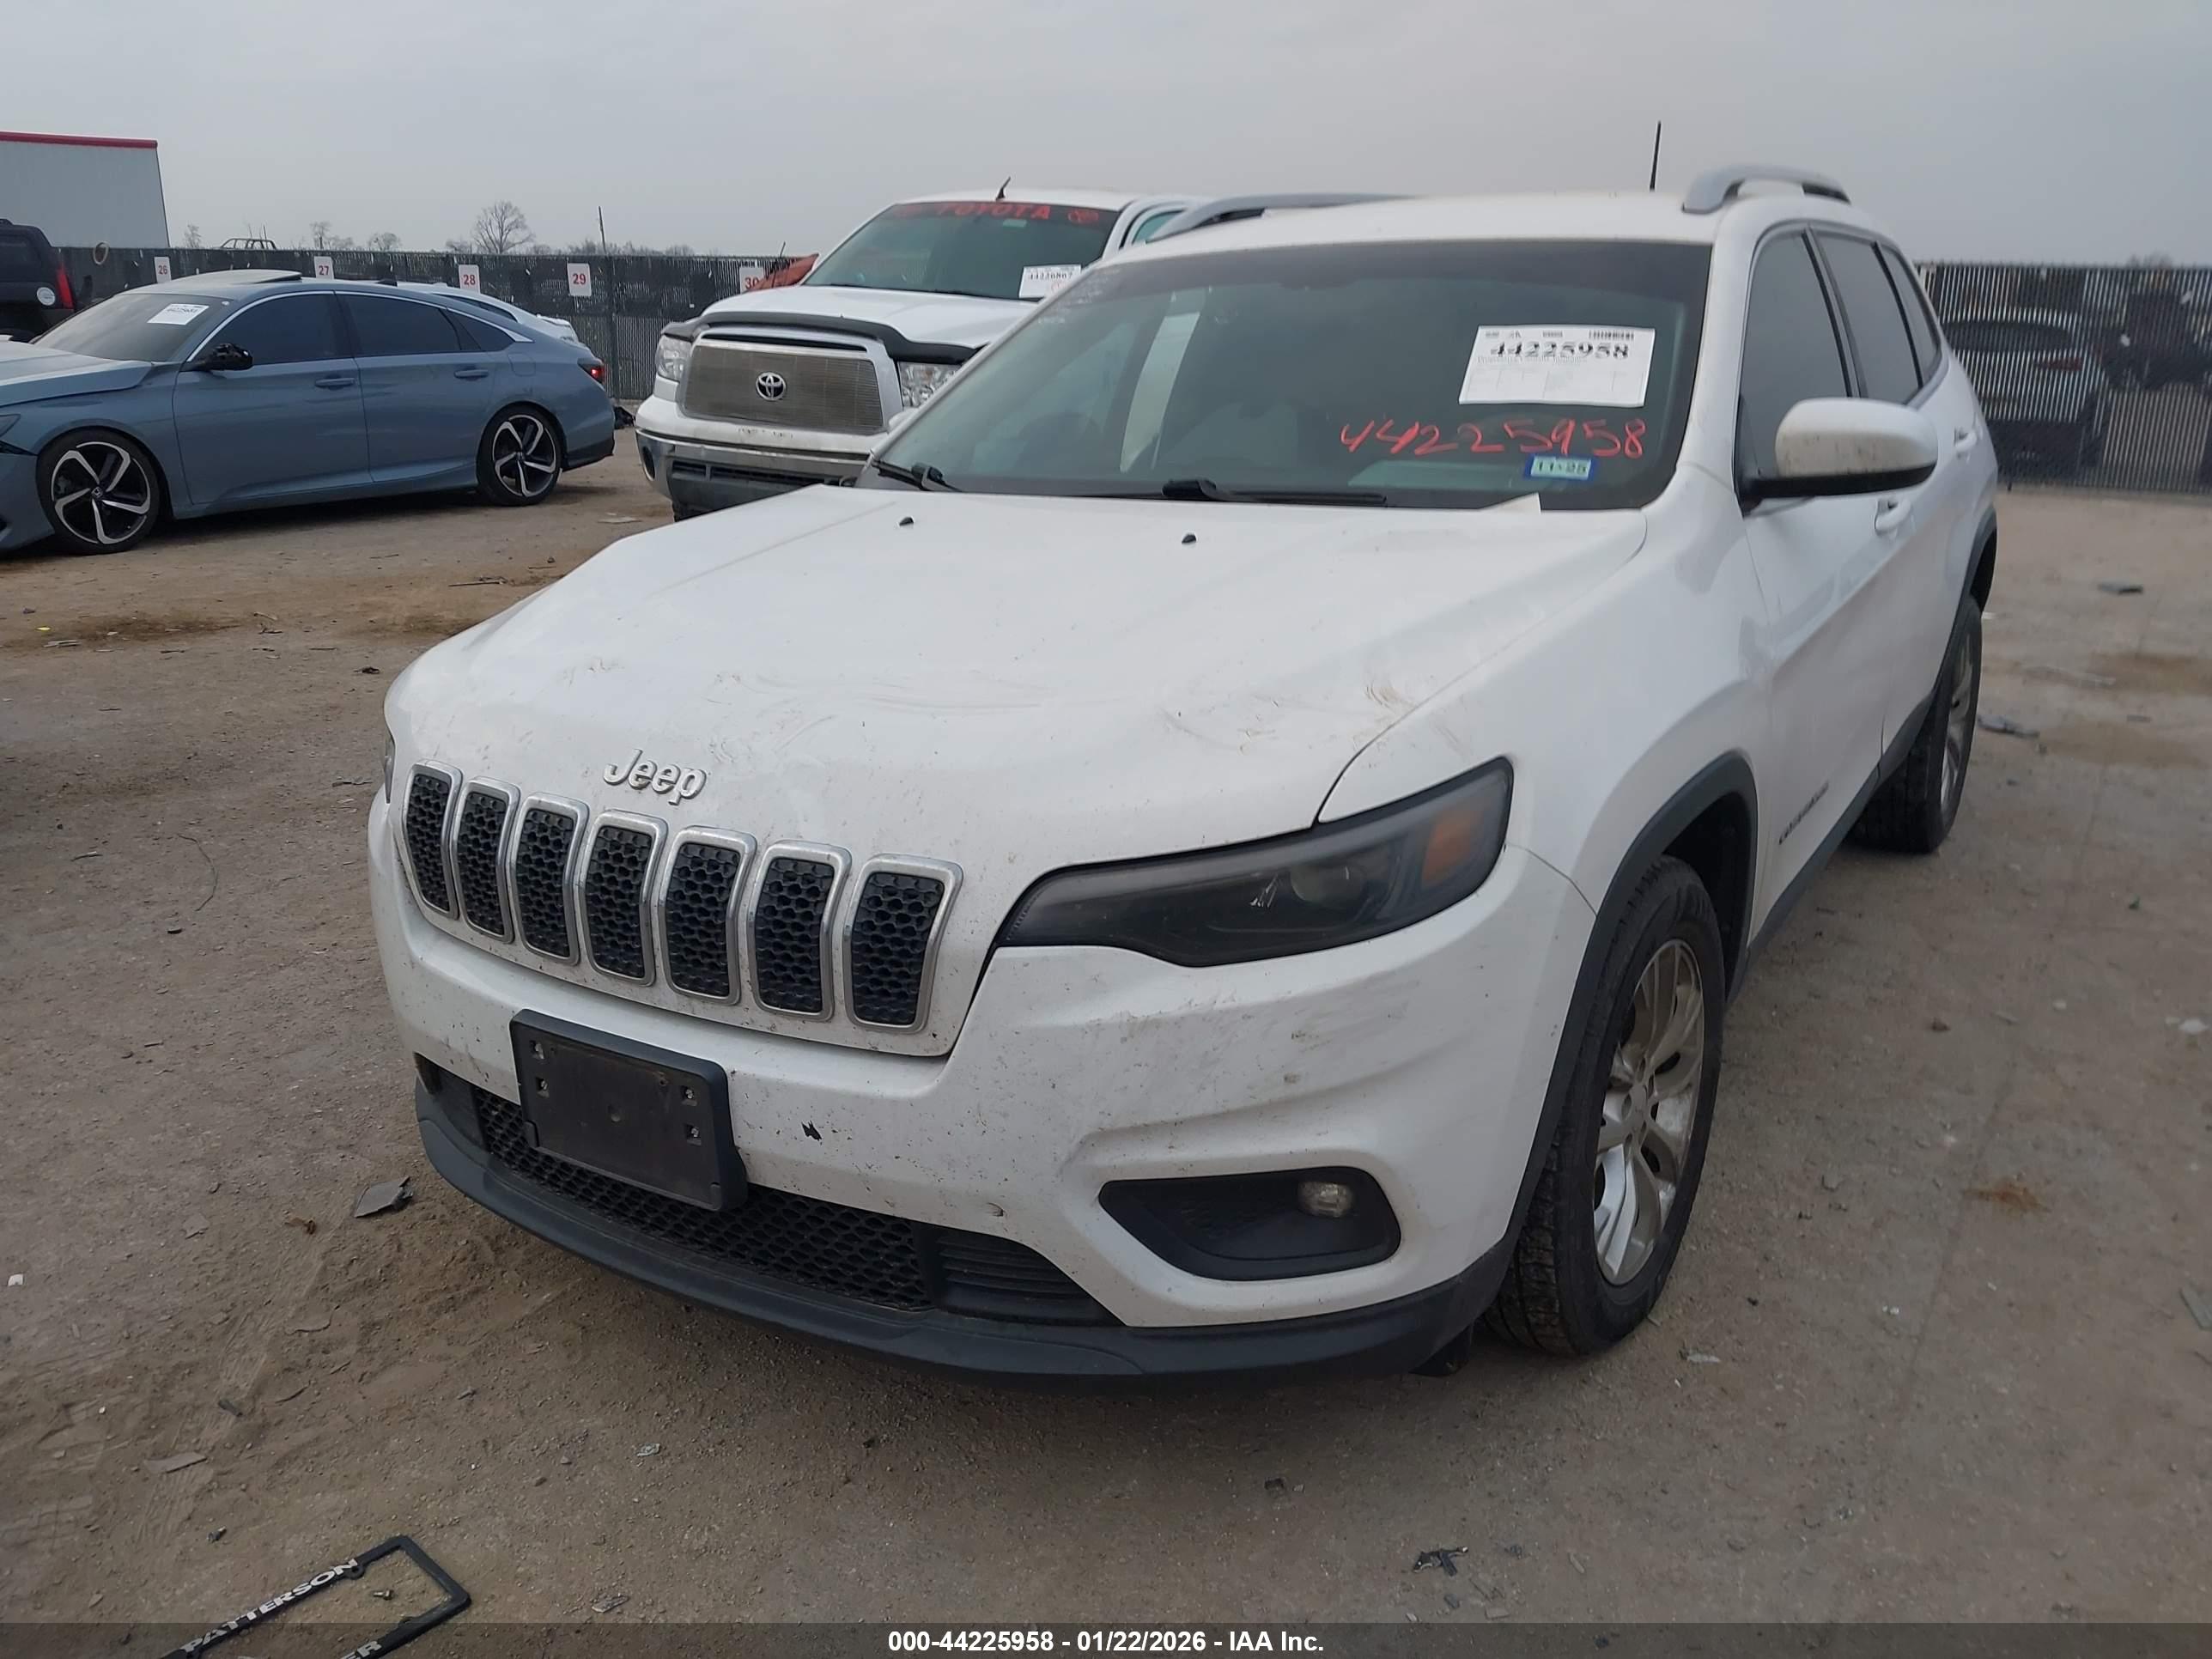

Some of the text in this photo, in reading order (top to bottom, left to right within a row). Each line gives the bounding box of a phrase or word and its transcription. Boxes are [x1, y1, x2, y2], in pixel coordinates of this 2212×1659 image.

[935, 204, 1050, 220] TOYOTA
[158, 265, 168, 275] 26
[319, 265, 330, 276] 27
[463, 275, 476, 285] 28
[573, 274, 586, 285] 29
[1490, 342, 1629, 360] 44225958
[1341, 419, 1645, 458] 44225958
[603, 749, 707, 805] Jeep
[180, 1559, 358, 1652] PATTERSON
